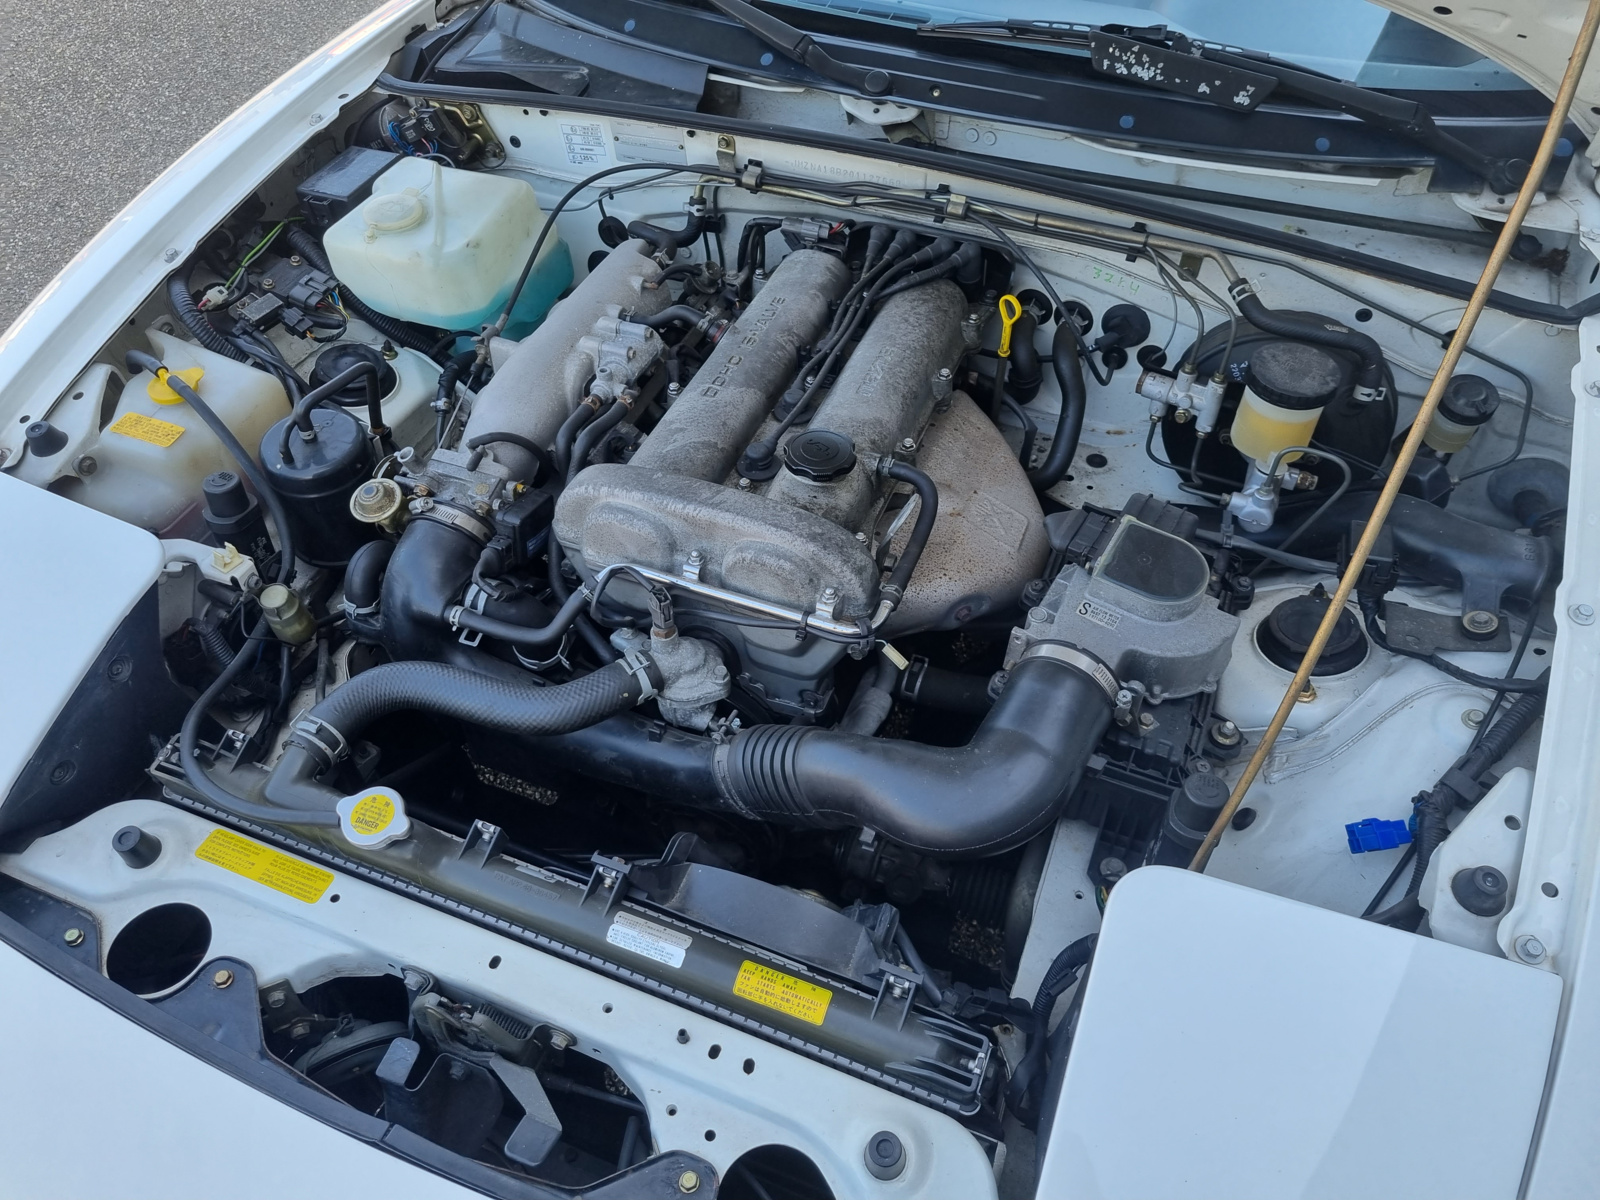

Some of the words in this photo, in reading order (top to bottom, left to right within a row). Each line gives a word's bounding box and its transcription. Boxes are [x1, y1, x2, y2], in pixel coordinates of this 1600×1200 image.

[1079, 602, 1092, 616] S
[355, 816, 379, 829] DANGER
[754, 966, 785, 981] DANGER
[760, 974, 777, 984] HANDS
[757, 980, 776, 991] STARTS
[781, 990, 823, 1008] AUTOMATICALLY
